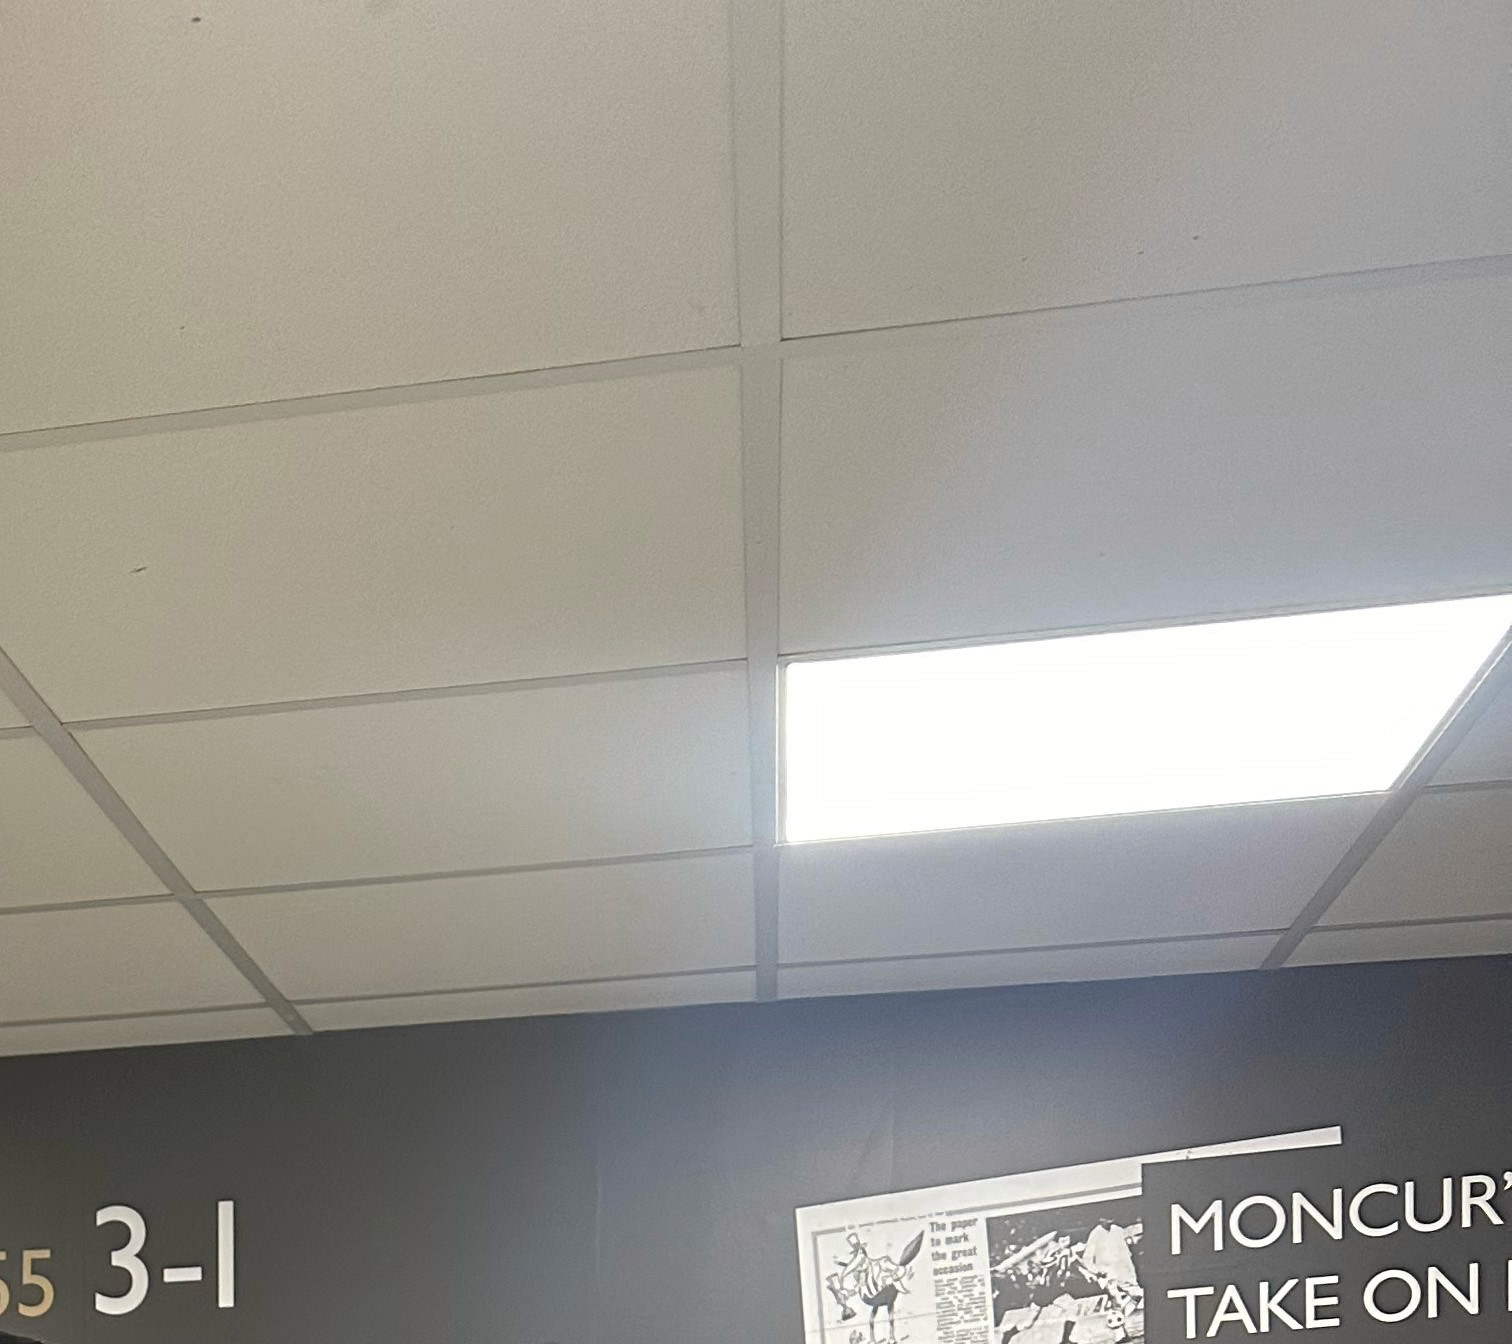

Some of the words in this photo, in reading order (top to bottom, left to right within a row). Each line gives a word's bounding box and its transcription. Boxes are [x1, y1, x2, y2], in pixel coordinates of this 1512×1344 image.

[950, 1218, 978, 1232] paper
[945, 1232, 969, 1246] mark
[95, 1200, 234, 1315] 3-1
[931, 1251, 947, 1261] the
[950, 1246, 977, 1260] great
[1167, 1275, 1340, 1338] TAKE
[1363, 1263, 1479, 1323] ON
